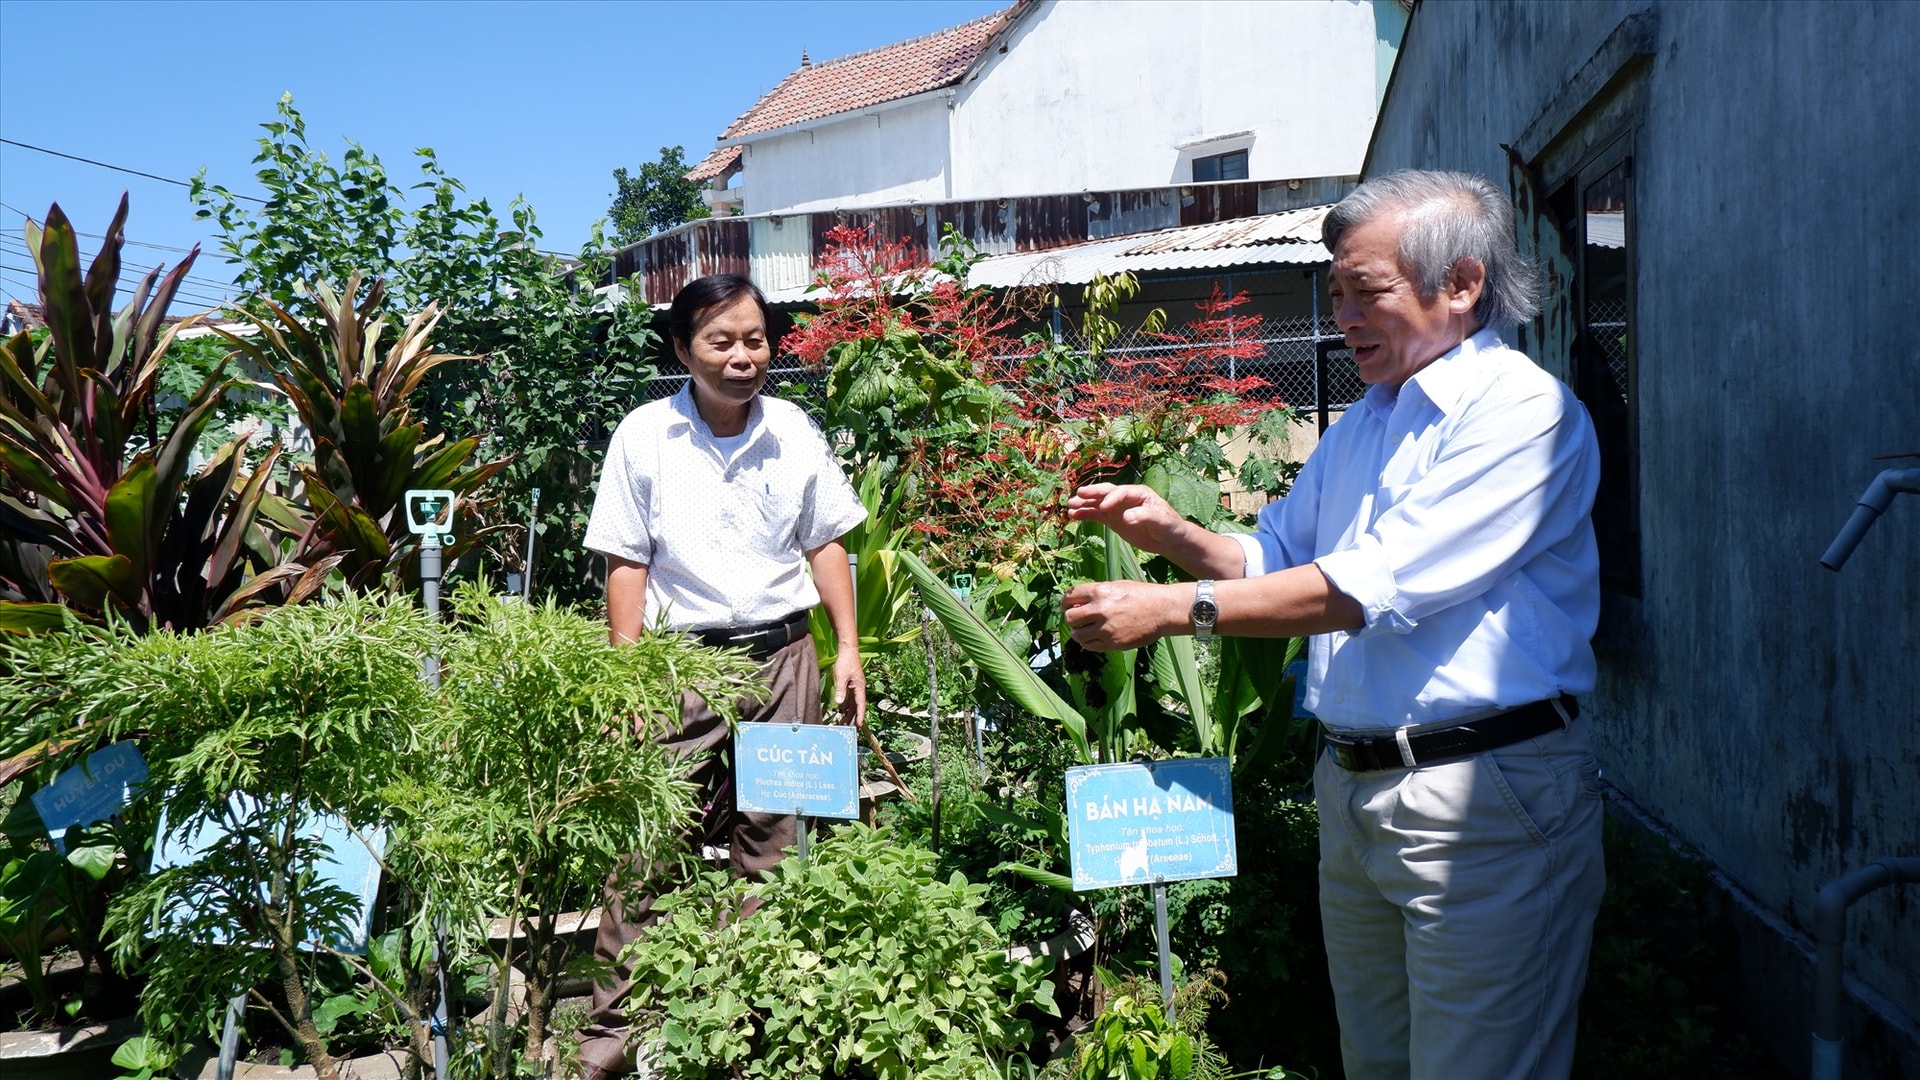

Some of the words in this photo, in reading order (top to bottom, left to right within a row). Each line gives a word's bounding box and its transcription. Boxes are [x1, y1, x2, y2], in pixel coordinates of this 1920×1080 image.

[756, 744, 793, 764] CÚC
[797, 743, 833, 765] TẨN
[1085, 795, 1128, 821] BÁN
[1133, 795, 1162, 820] HẠ
[1166, 792, 1213, 813] NAM
[1175, 836, 1189, 847] (L.)
